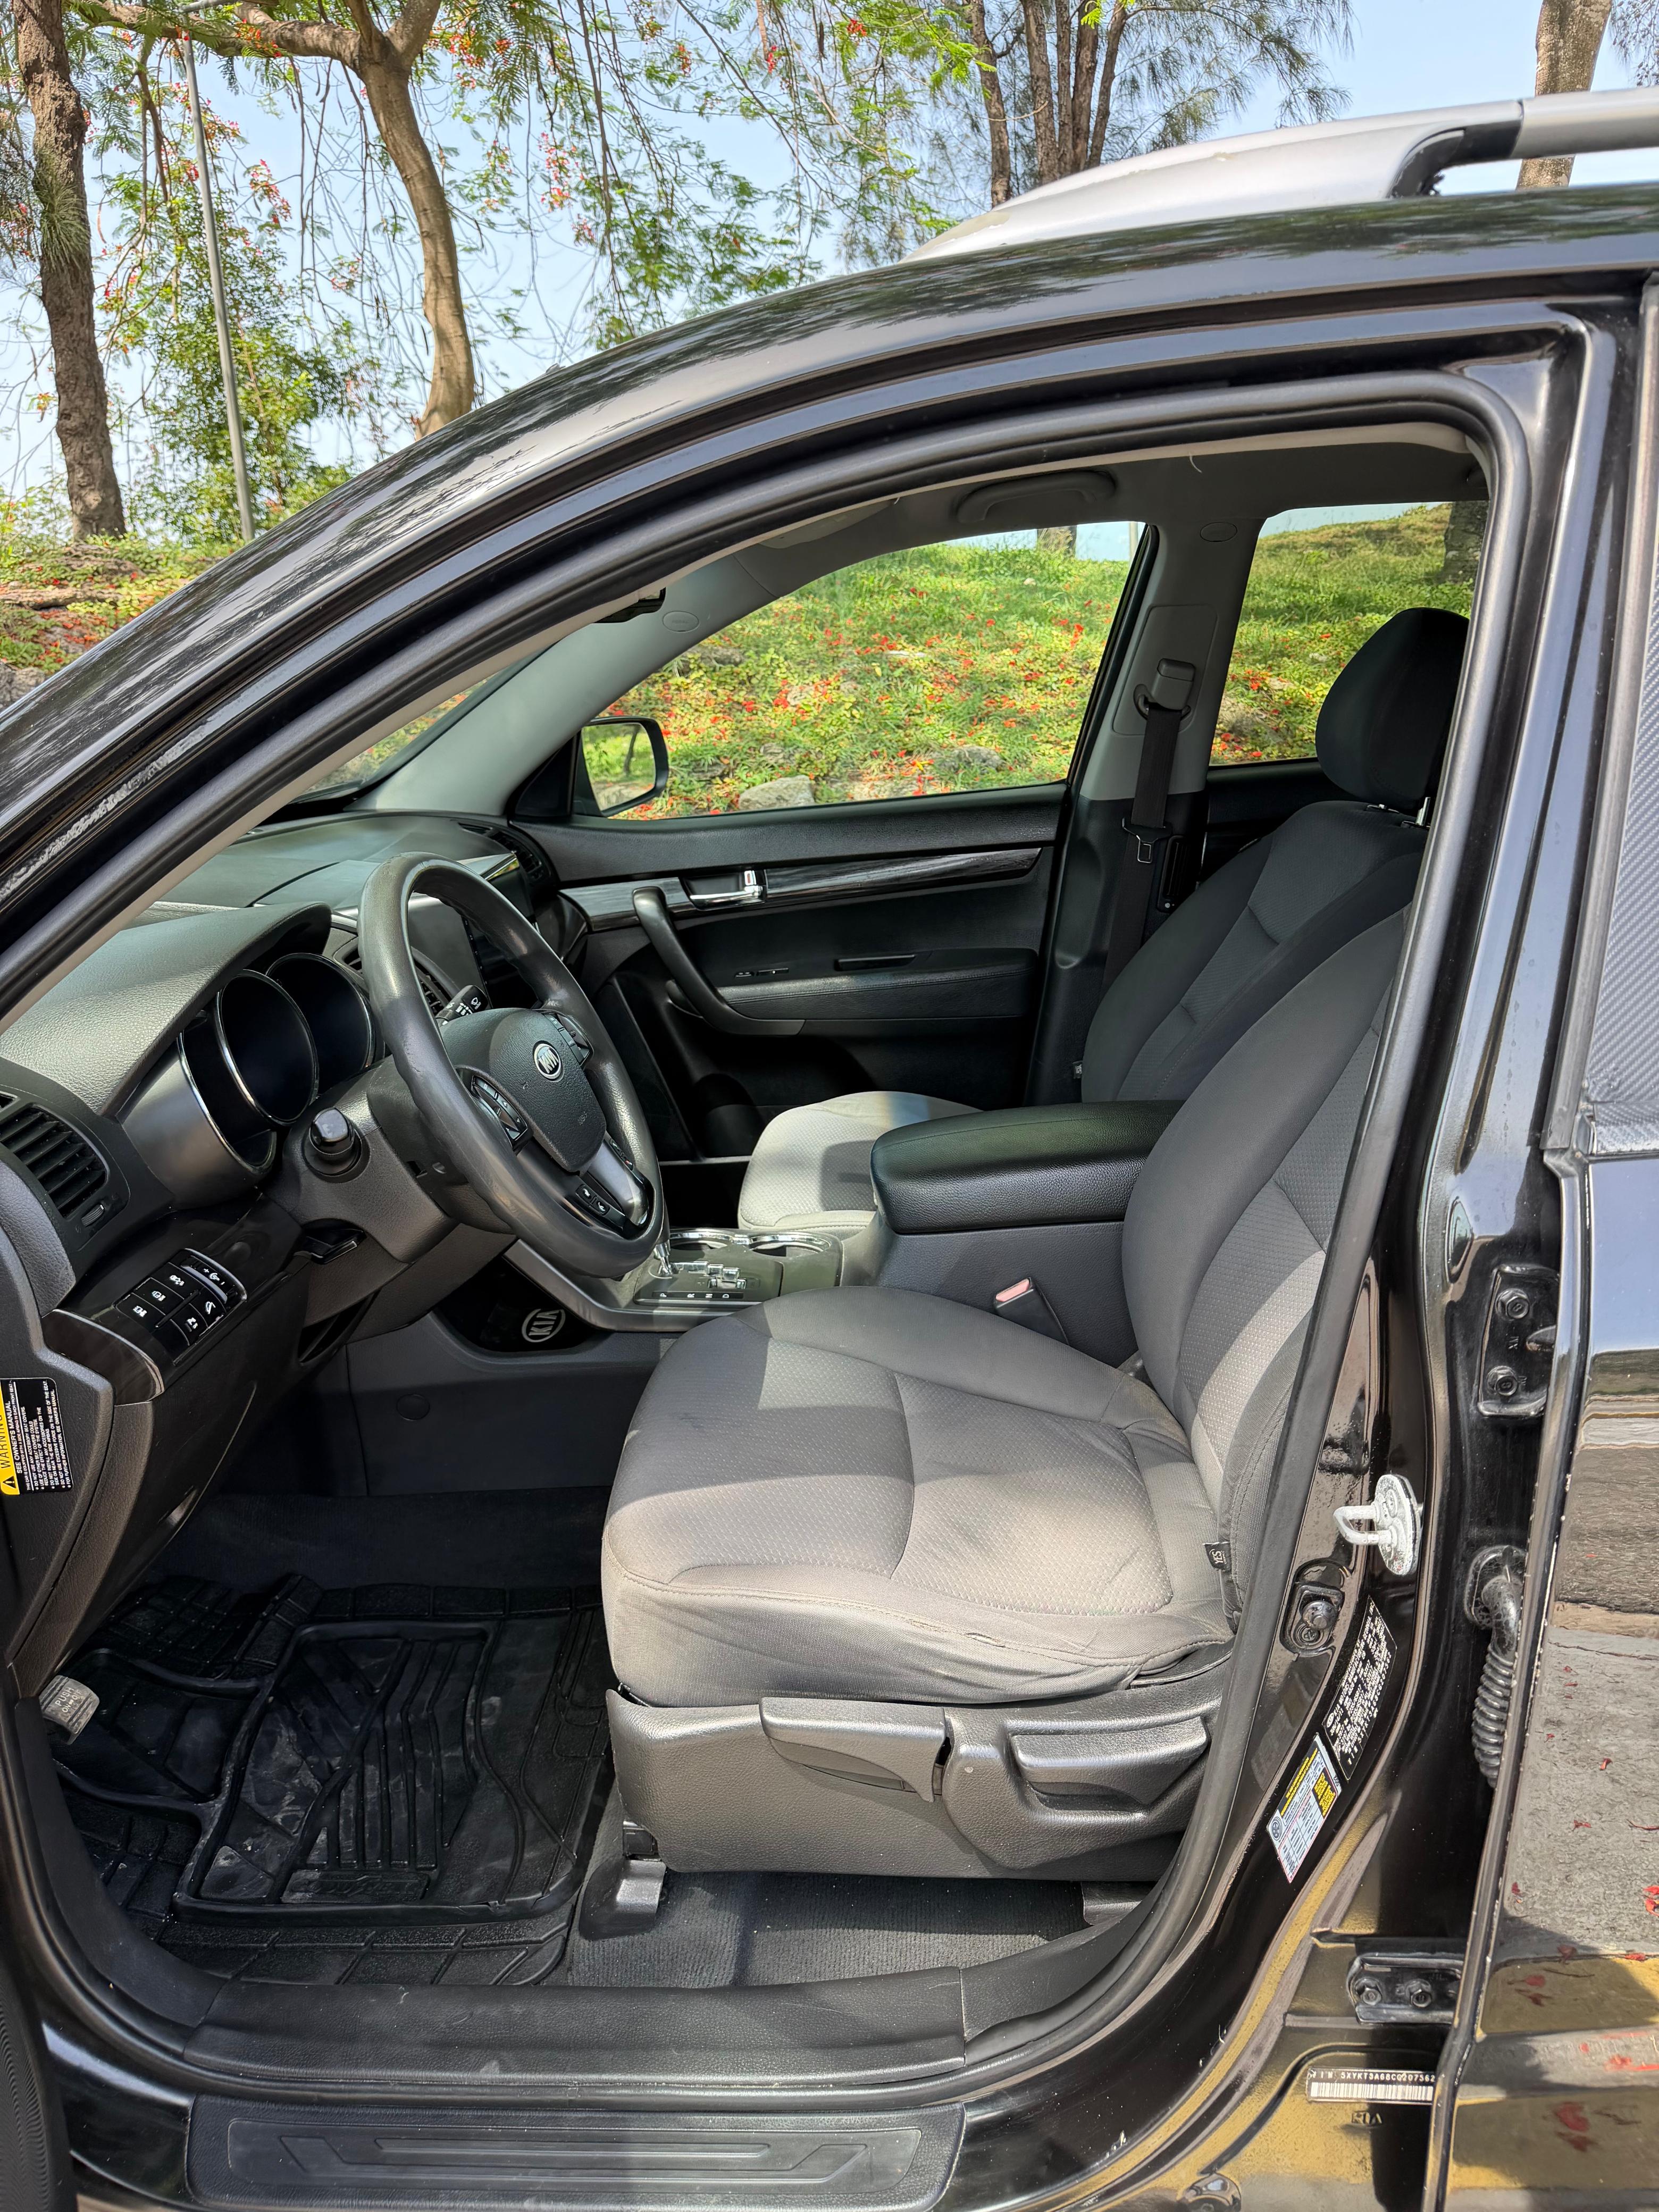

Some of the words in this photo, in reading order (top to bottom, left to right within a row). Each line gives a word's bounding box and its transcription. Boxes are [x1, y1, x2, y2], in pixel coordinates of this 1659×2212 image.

[537, 1046, 559, 1074] KIA
[527, 1309, 559, 1336] KIA
[4, 1401, 15, 1429] MANUAL
[0, 1414, 11, 1468] WARN
[9, 1429, 20, 1461] OWNER'S
[1212, 1551, 1224, 1564] YES
[55, 1687, 74, 1706] PUSH
[62, 1703, 71, 1713] ON
[1351, 2110, 1382, 2124] KIA
